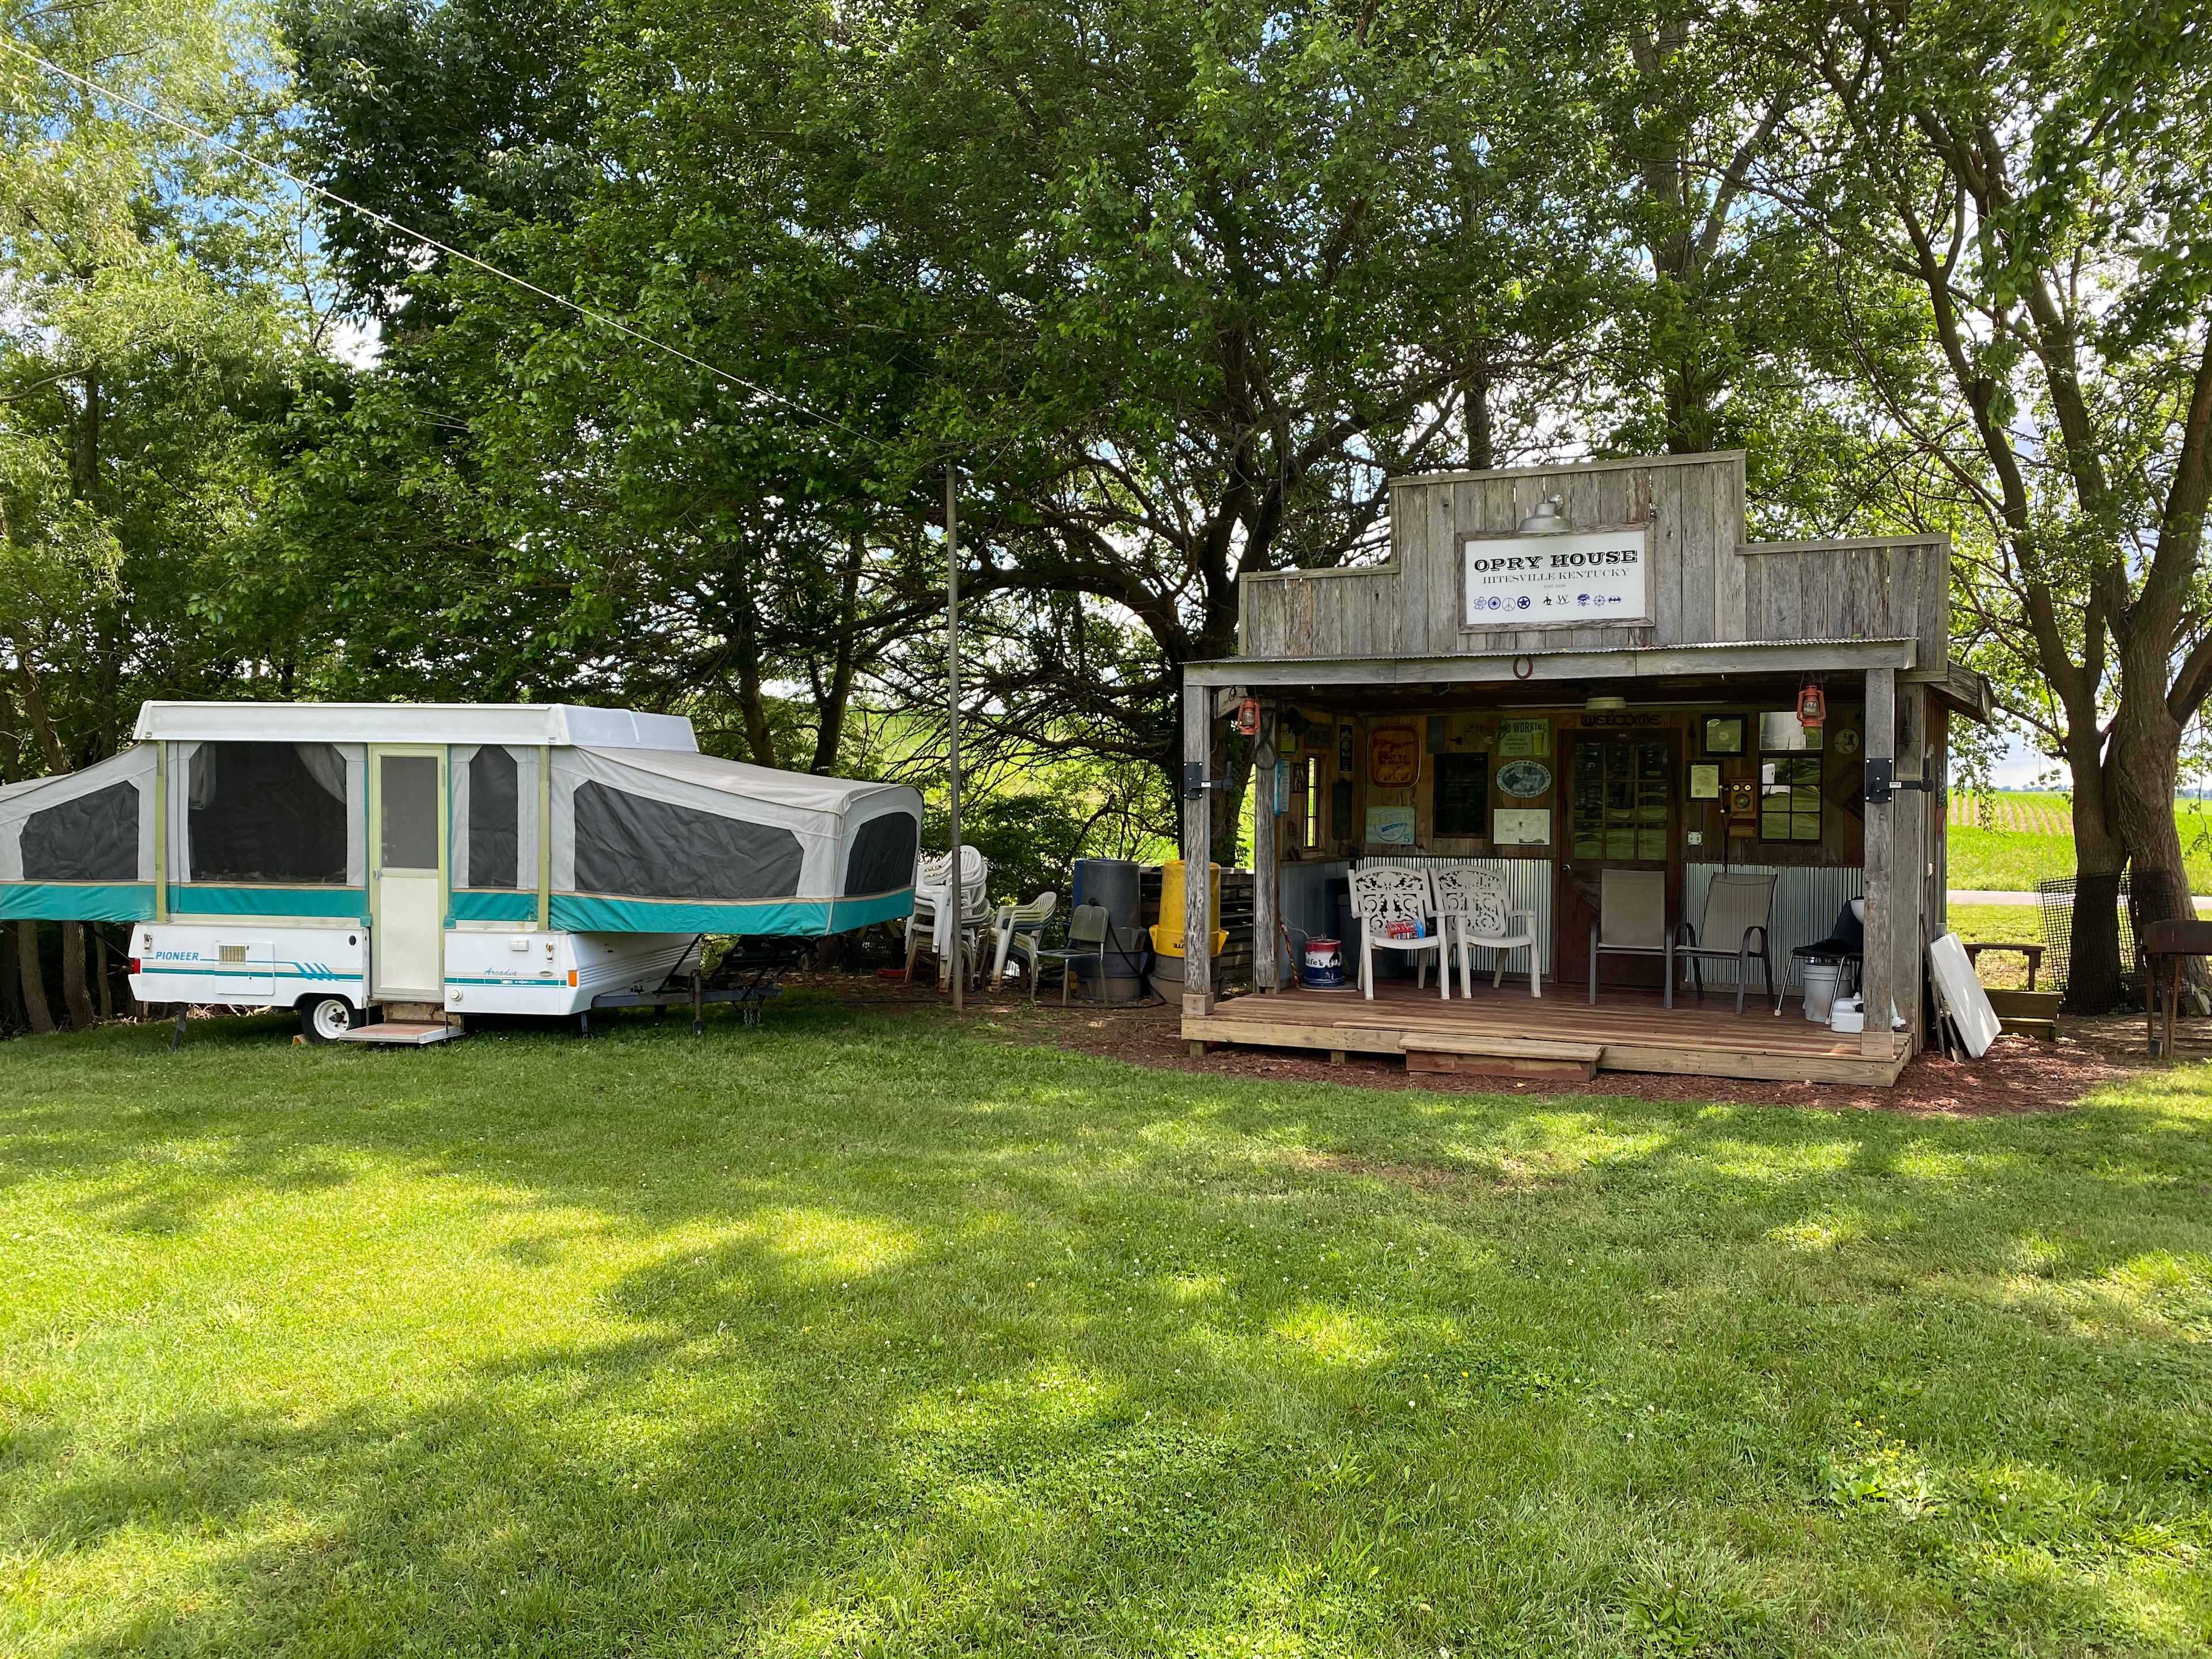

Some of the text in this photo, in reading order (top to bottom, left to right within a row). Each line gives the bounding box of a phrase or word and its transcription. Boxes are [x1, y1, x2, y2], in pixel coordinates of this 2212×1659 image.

[1475, 550, 1638, 572] OPRY HOUSE
[1483, 569, 1629, 584] HITESVILLE KENTUCKY
[156, 951, 199, 961] PIONEER
[484, 968, 517, 976] Arcadia
